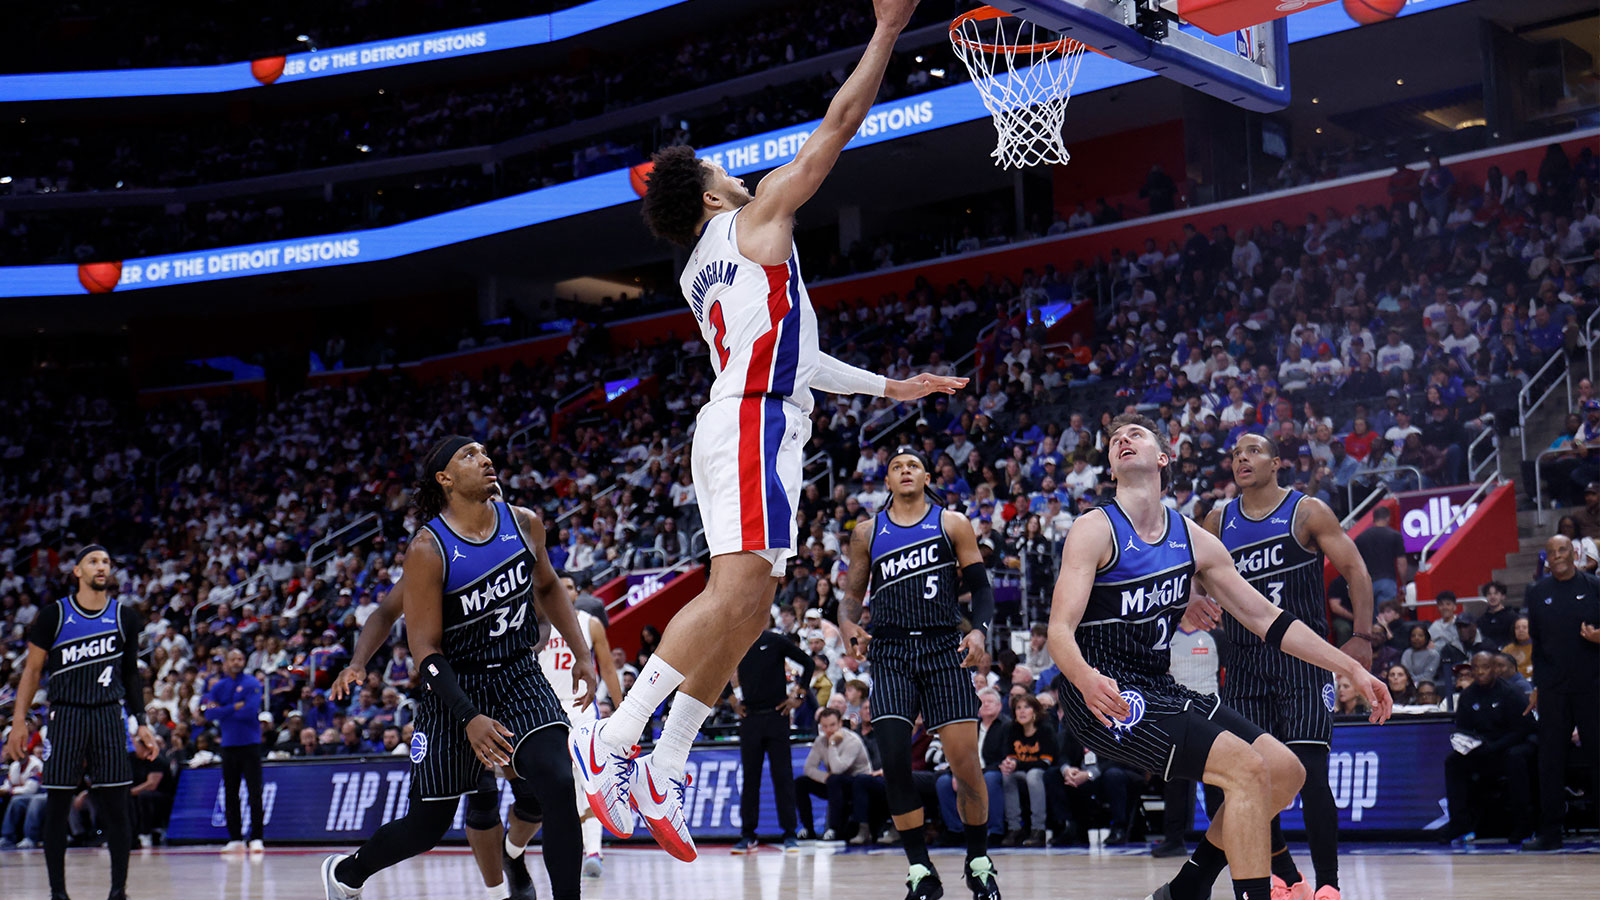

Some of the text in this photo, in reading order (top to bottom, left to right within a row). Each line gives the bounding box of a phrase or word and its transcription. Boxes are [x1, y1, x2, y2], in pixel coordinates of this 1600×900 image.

[308, 56, 330, 72] OF
[331, 52, 358, 69] THE
[360, 42, 421, 65] DETROIT
[423, 32, 487, 55] PISTONS
[726, 143, 760, 169] THE
[859, 101, 934, 138] ISTONS
[146, 261, 170, 281] OF
[173, 257, 205, 277] THE
[207, 248, 280, 274] DETROIT
[284, 238, 360, 264] PISTONS
[691, 260, 738, 323] CUNNINGHAM
[709, 299, 731, 373] 2
[1233, 543, 1284, 573] AGIC
[923, 575, 939, 600] 5
[489, 602, 527, 637] 34
[97, 665, 114, 687] 4
[554, 652, 572, 670] 12
[325, 771, 380, 832] TAP
